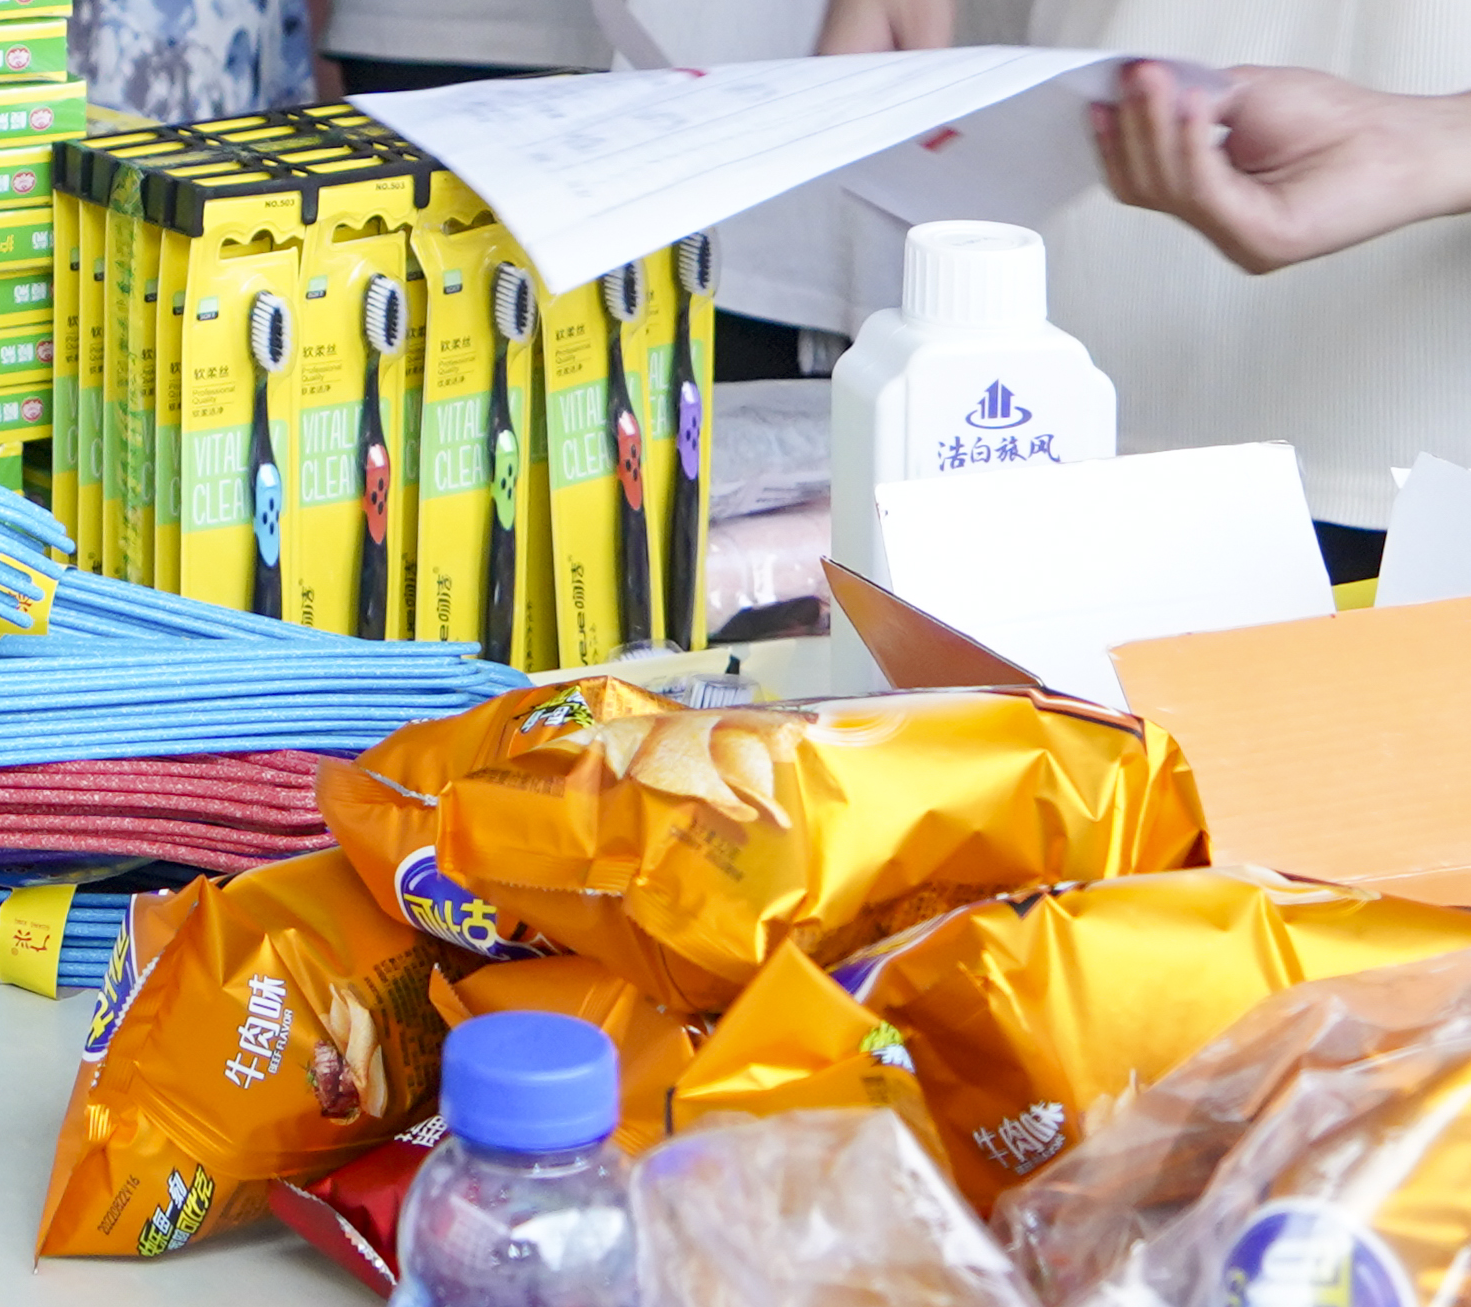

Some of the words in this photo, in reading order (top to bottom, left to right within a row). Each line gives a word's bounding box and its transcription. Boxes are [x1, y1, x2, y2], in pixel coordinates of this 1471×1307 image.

[434, 444, 486, 492] CLEA
[563, 433, 609, 481] CLEA
[191, 477, 251, 526] CLEA
[13, 929, 51, 953] 广兴
[224, 973, 286, 1089] 牛肉味
[268, 1049, 281, 1074] BEEF
[275, 1008, 293, 1051] FLAVOR
